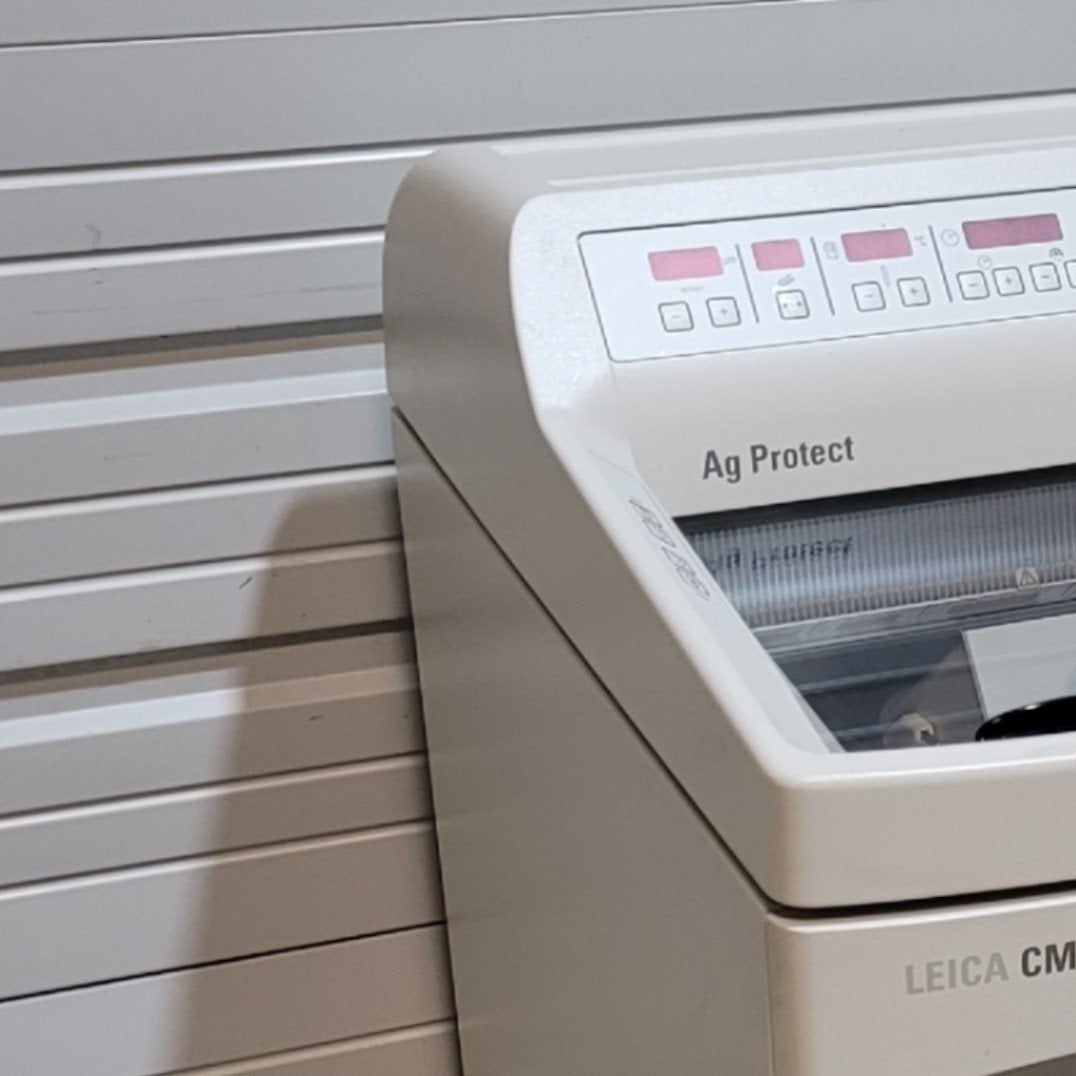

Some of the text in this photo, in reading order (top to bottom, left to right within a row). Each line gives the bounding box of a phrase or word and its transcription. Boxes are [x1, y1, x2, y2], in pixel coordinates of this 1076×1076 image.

[702, 436, 855, 484] Ag Protect
[904, 951, 1010, 996] LEICA
